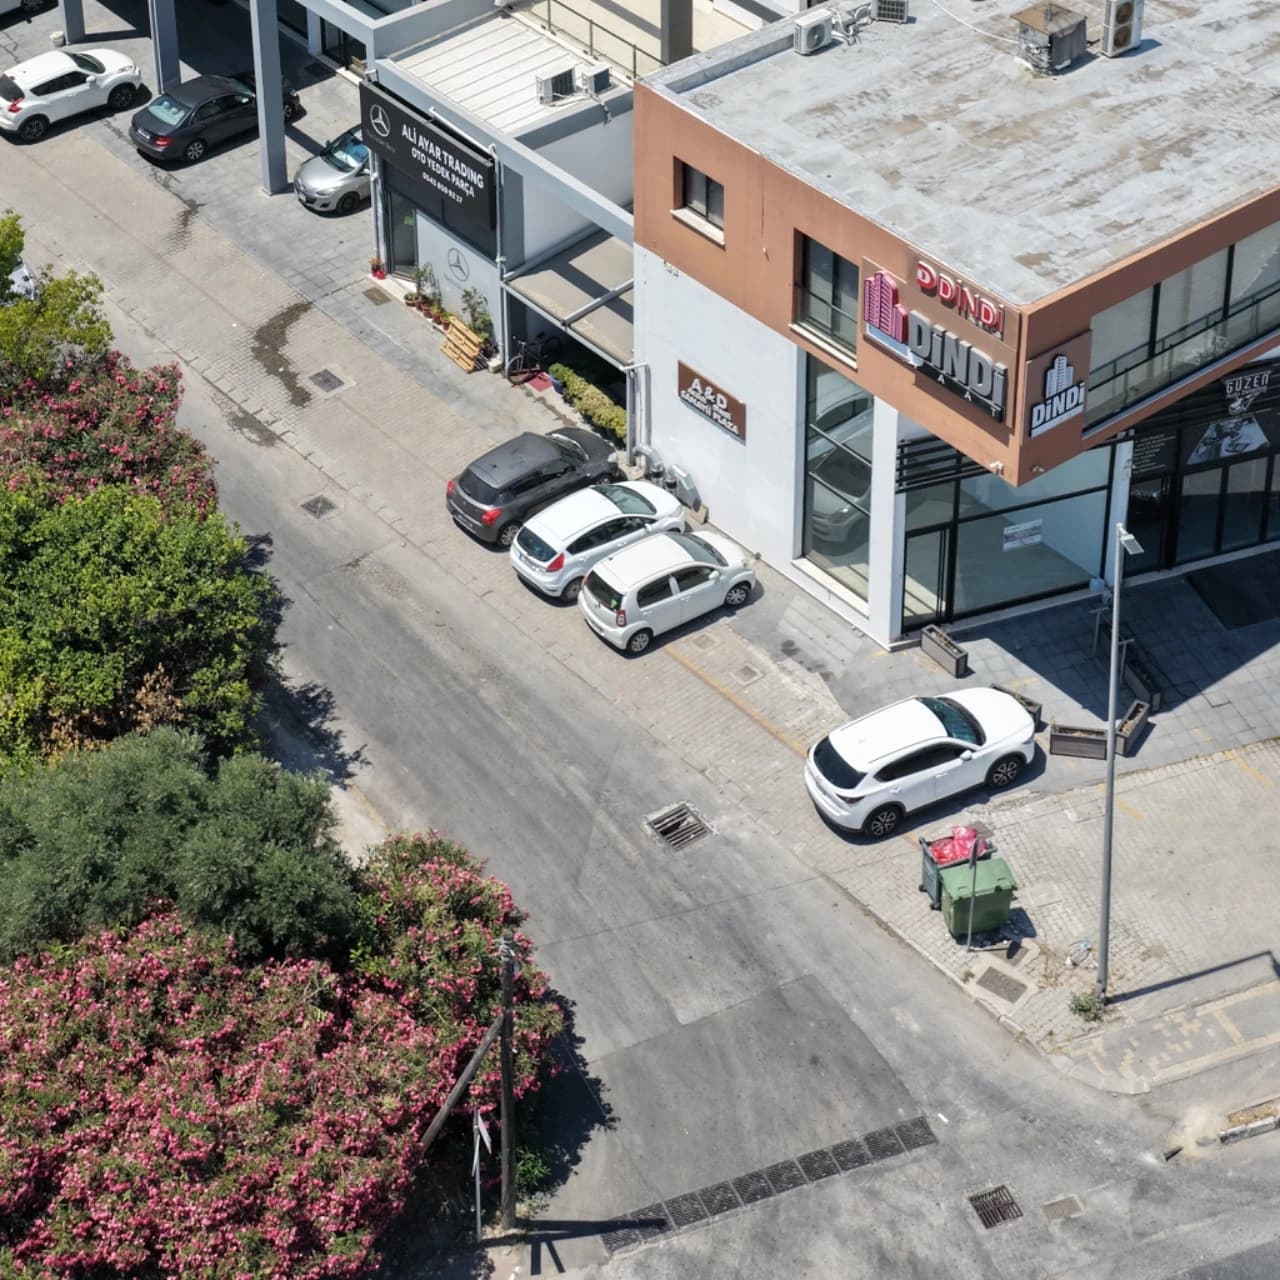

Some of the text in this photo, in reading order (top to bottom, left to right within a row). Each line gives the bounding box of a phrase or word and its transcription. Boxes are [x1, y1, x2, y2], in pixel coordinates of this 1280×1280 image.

[402, 123, 417, 145] ALİ
[418, 135, 441, 161] AYAR
[442, 149, 484, 189] TRADING
[411, 147, 475, 198] OTO YEDEK PARÇA
[938, 272, 1006, 333] DİNDİ
[908, 309, 1009, 407] DİNDİ
[1031, 381, 1087, 430] DİNDİ
